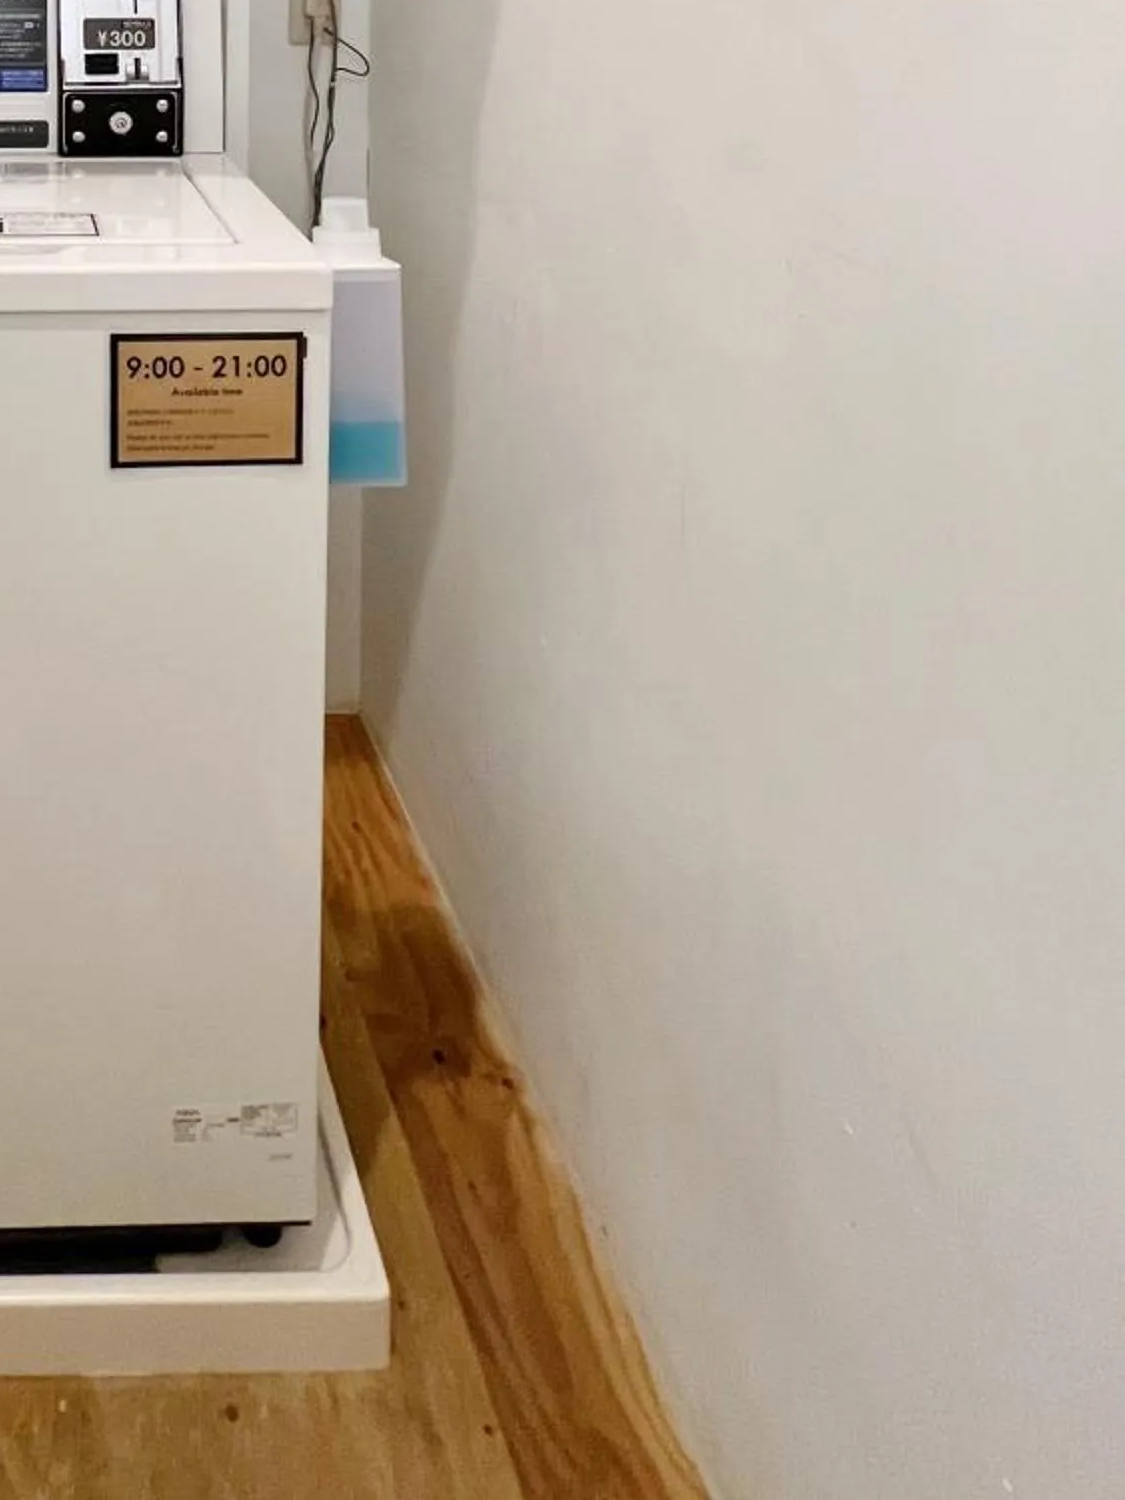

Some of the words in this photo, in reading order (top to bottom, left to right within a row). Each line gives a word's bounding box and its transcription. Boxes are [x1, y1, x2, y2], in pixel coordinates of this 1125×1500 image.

[98, 30, 147, 47] ¥300
[126, 356, 185, 379] 9:00
[212, 355, 288, 378] 21:00
